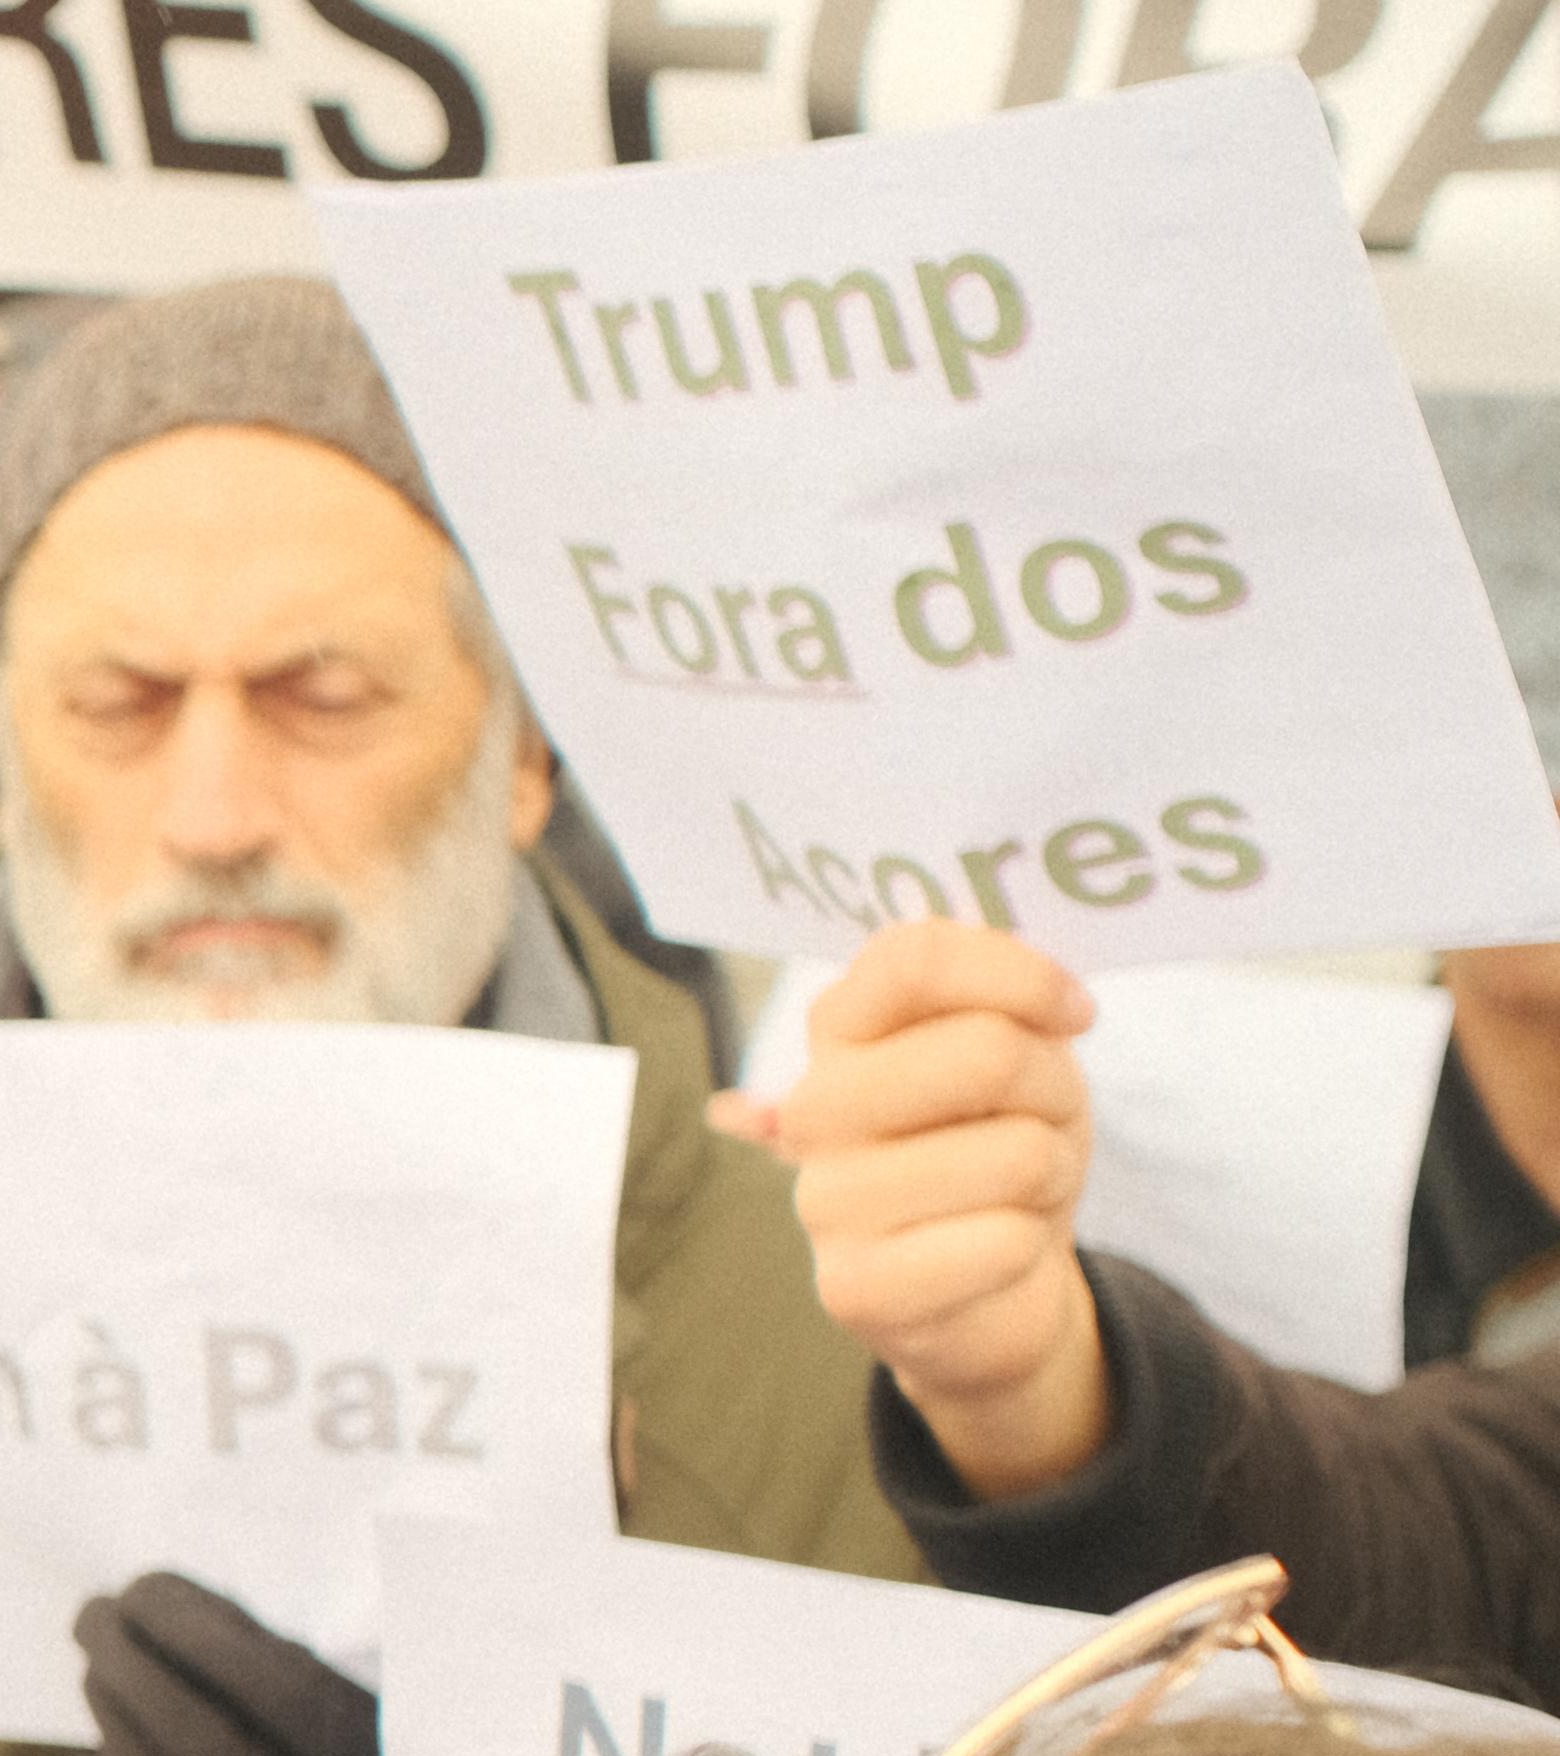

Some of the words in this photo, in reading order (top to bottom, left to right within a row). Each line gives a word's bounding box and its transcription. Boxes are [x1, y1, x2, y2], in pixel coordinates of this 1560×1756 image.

[507, 248, 1031, 404] Trump
[563, 537, 857, 684] Fora
[890, 513, 1250, 671] dos
[72, 1314, 149, 1452] à
[205, 1325, 484, 1463] Paz
